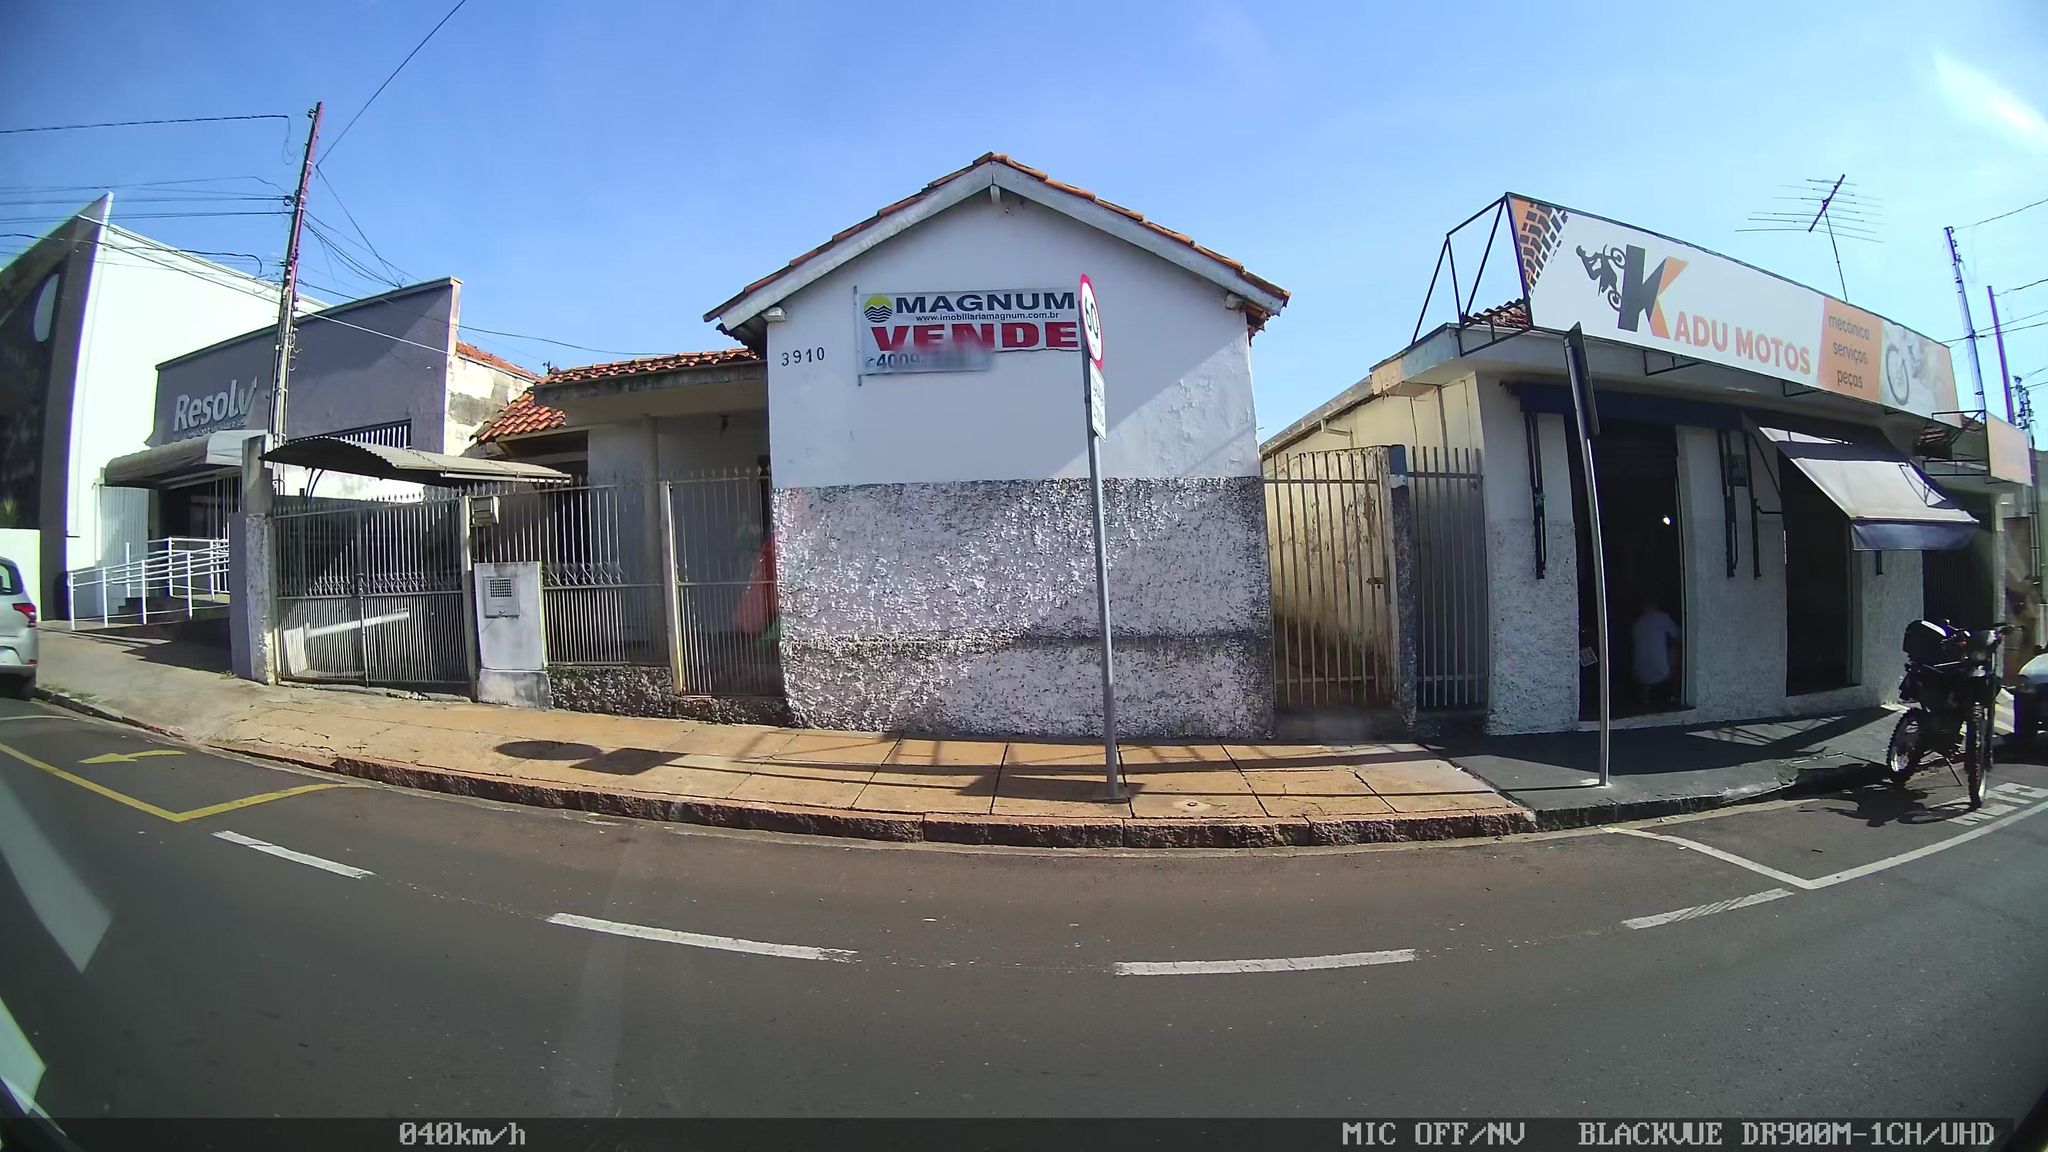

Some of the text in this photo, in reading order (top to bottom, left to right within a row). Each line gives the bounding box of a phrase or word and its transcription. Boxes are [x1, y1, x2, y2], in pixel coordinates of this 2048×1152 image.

[896, 292, 1075, 314] MAGNUM
[915, 311, 1060, 322] www.imobiliariamagnum.com.br
[1084, 296, 1099, 340] 60
[871, 321, 1078, 352] VENDE
[781, 346, 825, 367] 3910
[1735, 327, 1811, 375] MOTOS
[1832, 341, 1868, 366] serviços
[1836, 369, 1863, 390] peças
